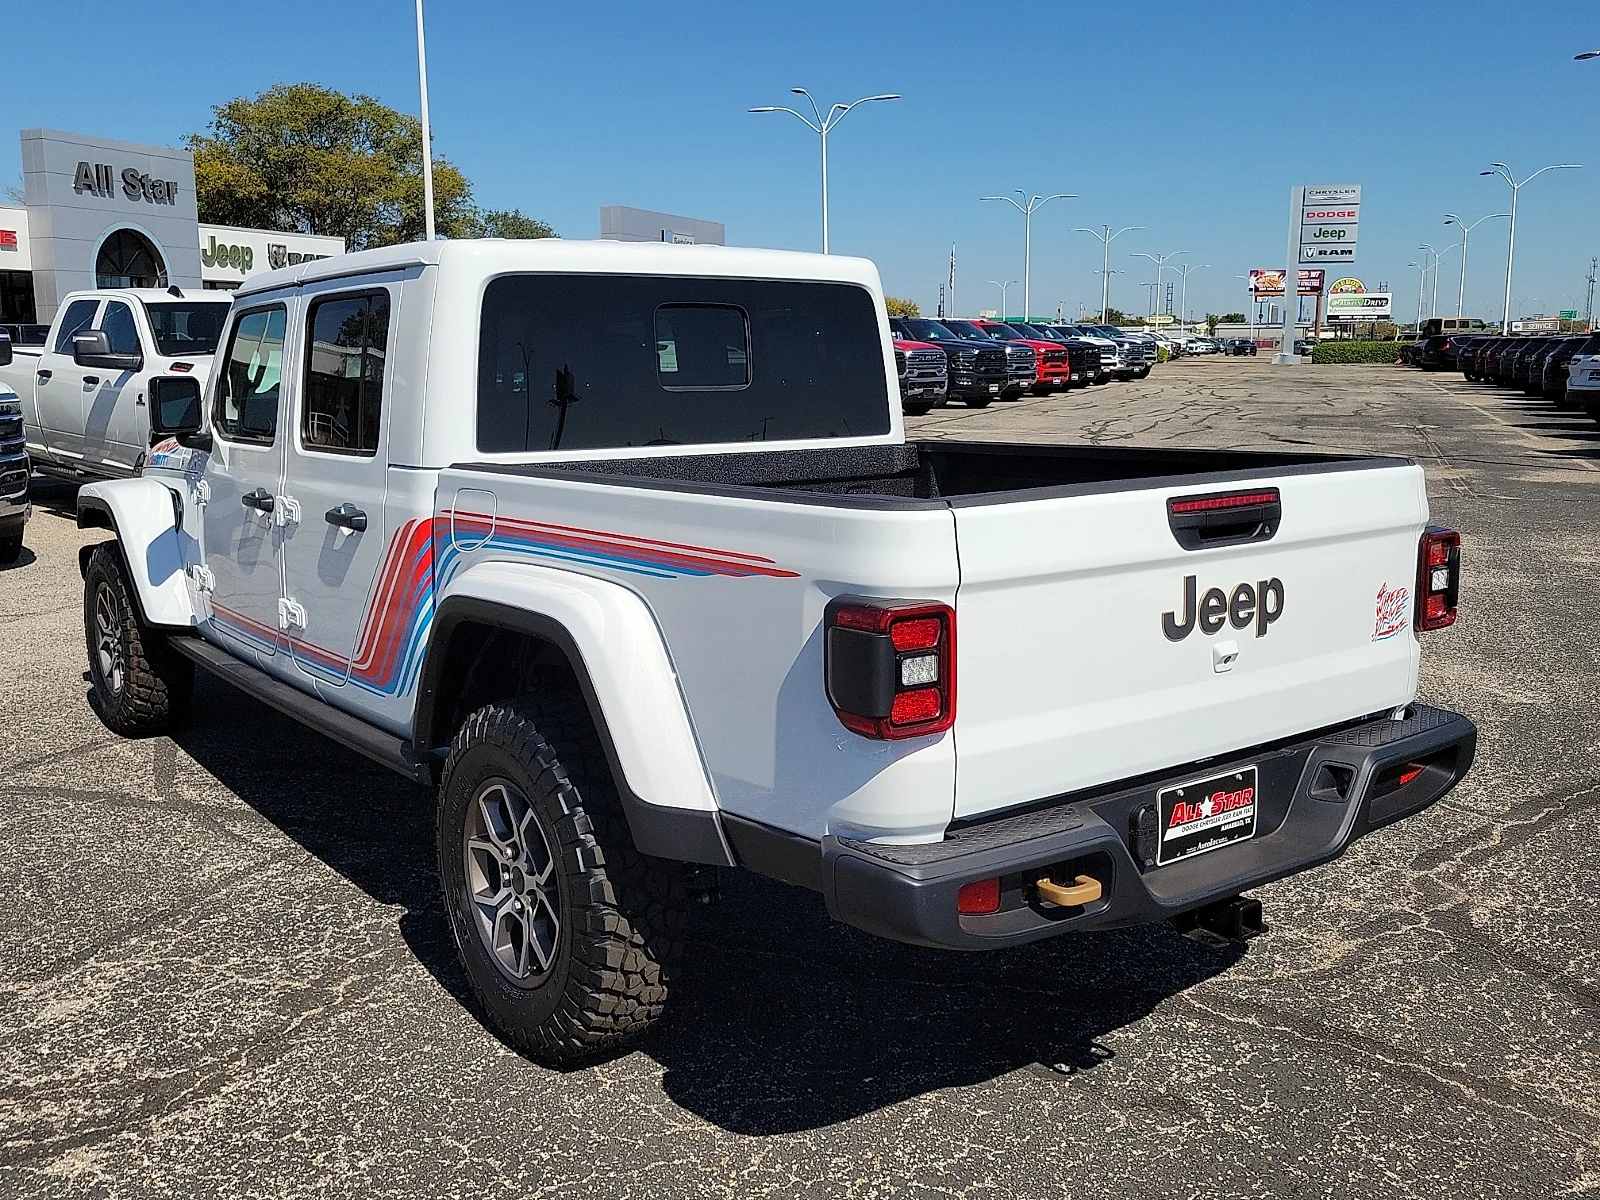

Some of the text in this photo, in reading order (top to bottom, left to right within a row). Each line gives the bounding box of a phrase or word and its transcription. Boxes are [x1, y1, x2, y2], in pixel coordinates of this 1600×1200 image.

[74, 161, 178, 205] All Star
[1313, 227, 1346, 240] Jeep
[201, 235, 254, 275] Jeep
[1162, 575, 1285, 642] Jeep
[1169, 788, 1254, 827] ALL STAR
